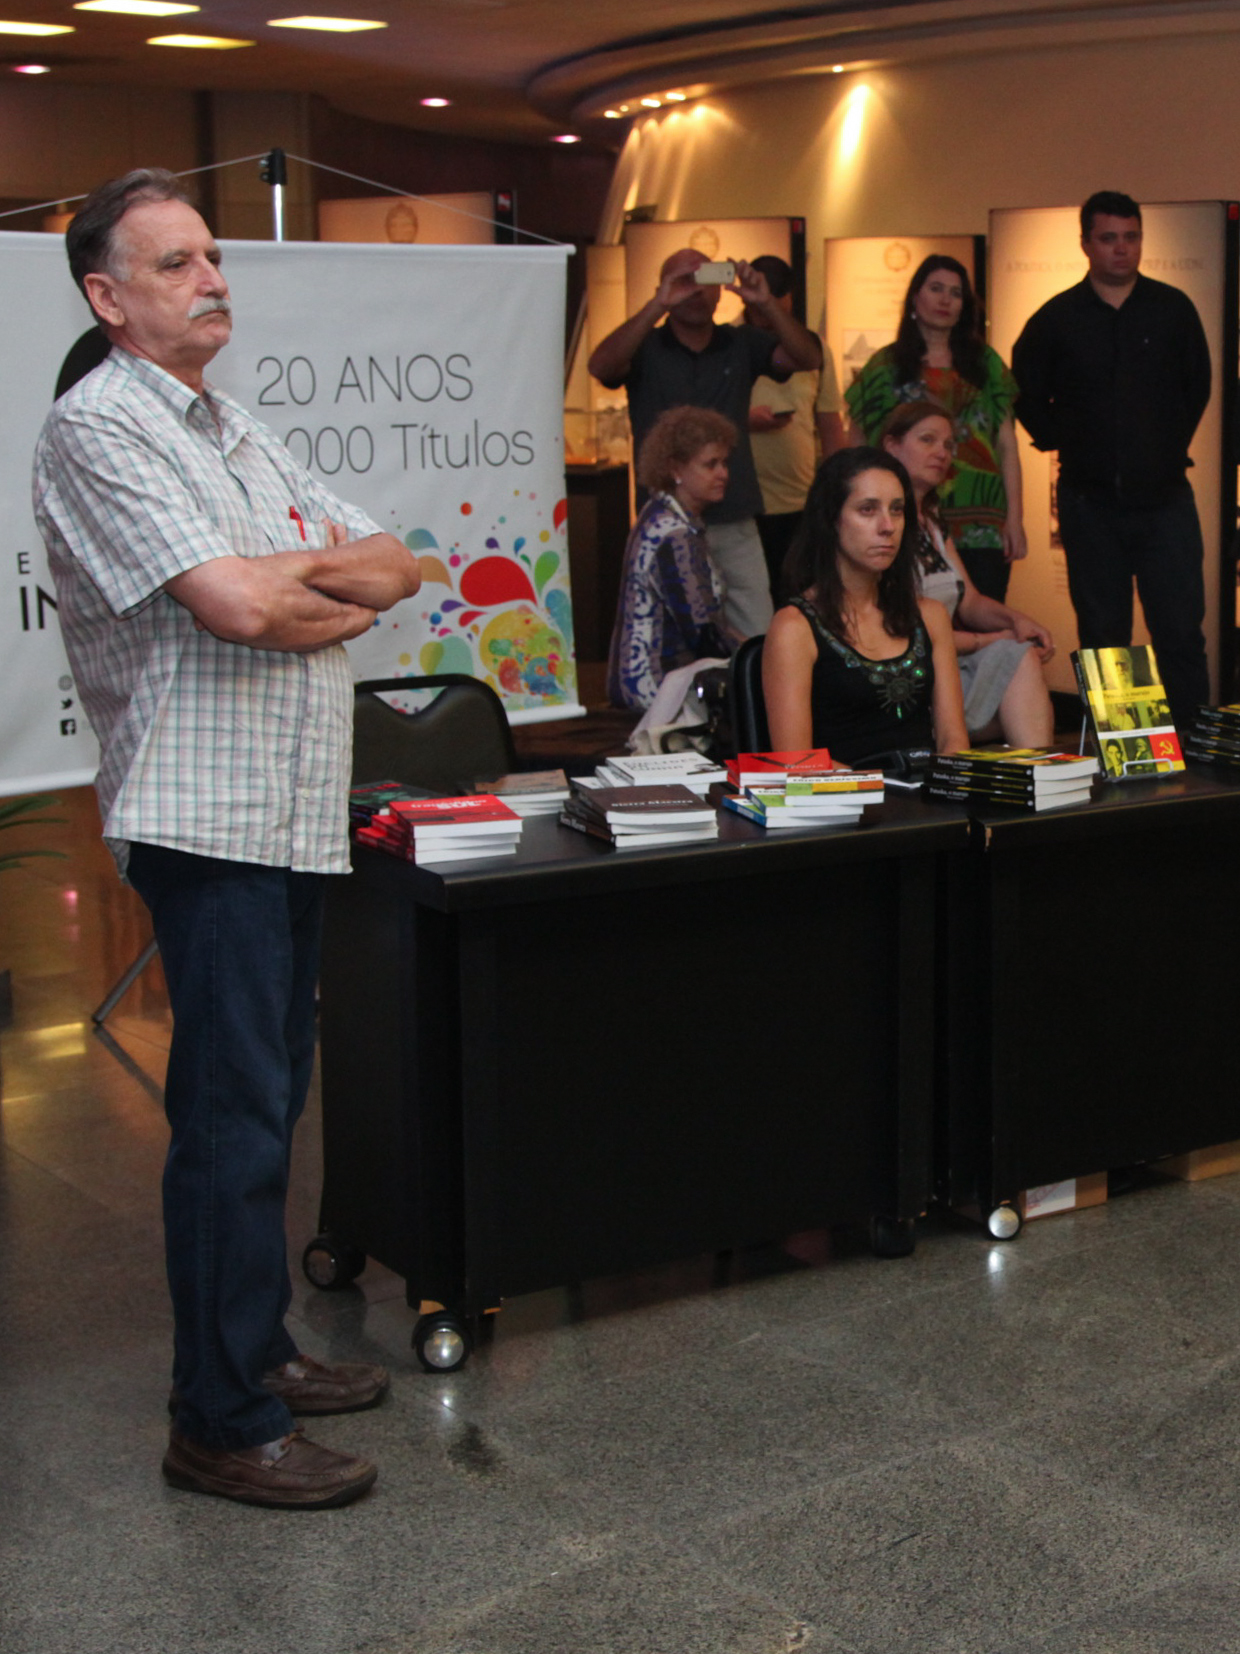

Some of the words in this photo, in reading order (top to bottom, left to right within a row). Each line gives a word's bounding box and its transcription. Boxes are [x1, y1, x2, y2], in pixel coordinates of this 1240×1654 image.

[257, 356, 316, 405] 20
[334, 354, 473, 403] ANOS
[391, 418, 535, 470] Títulos
